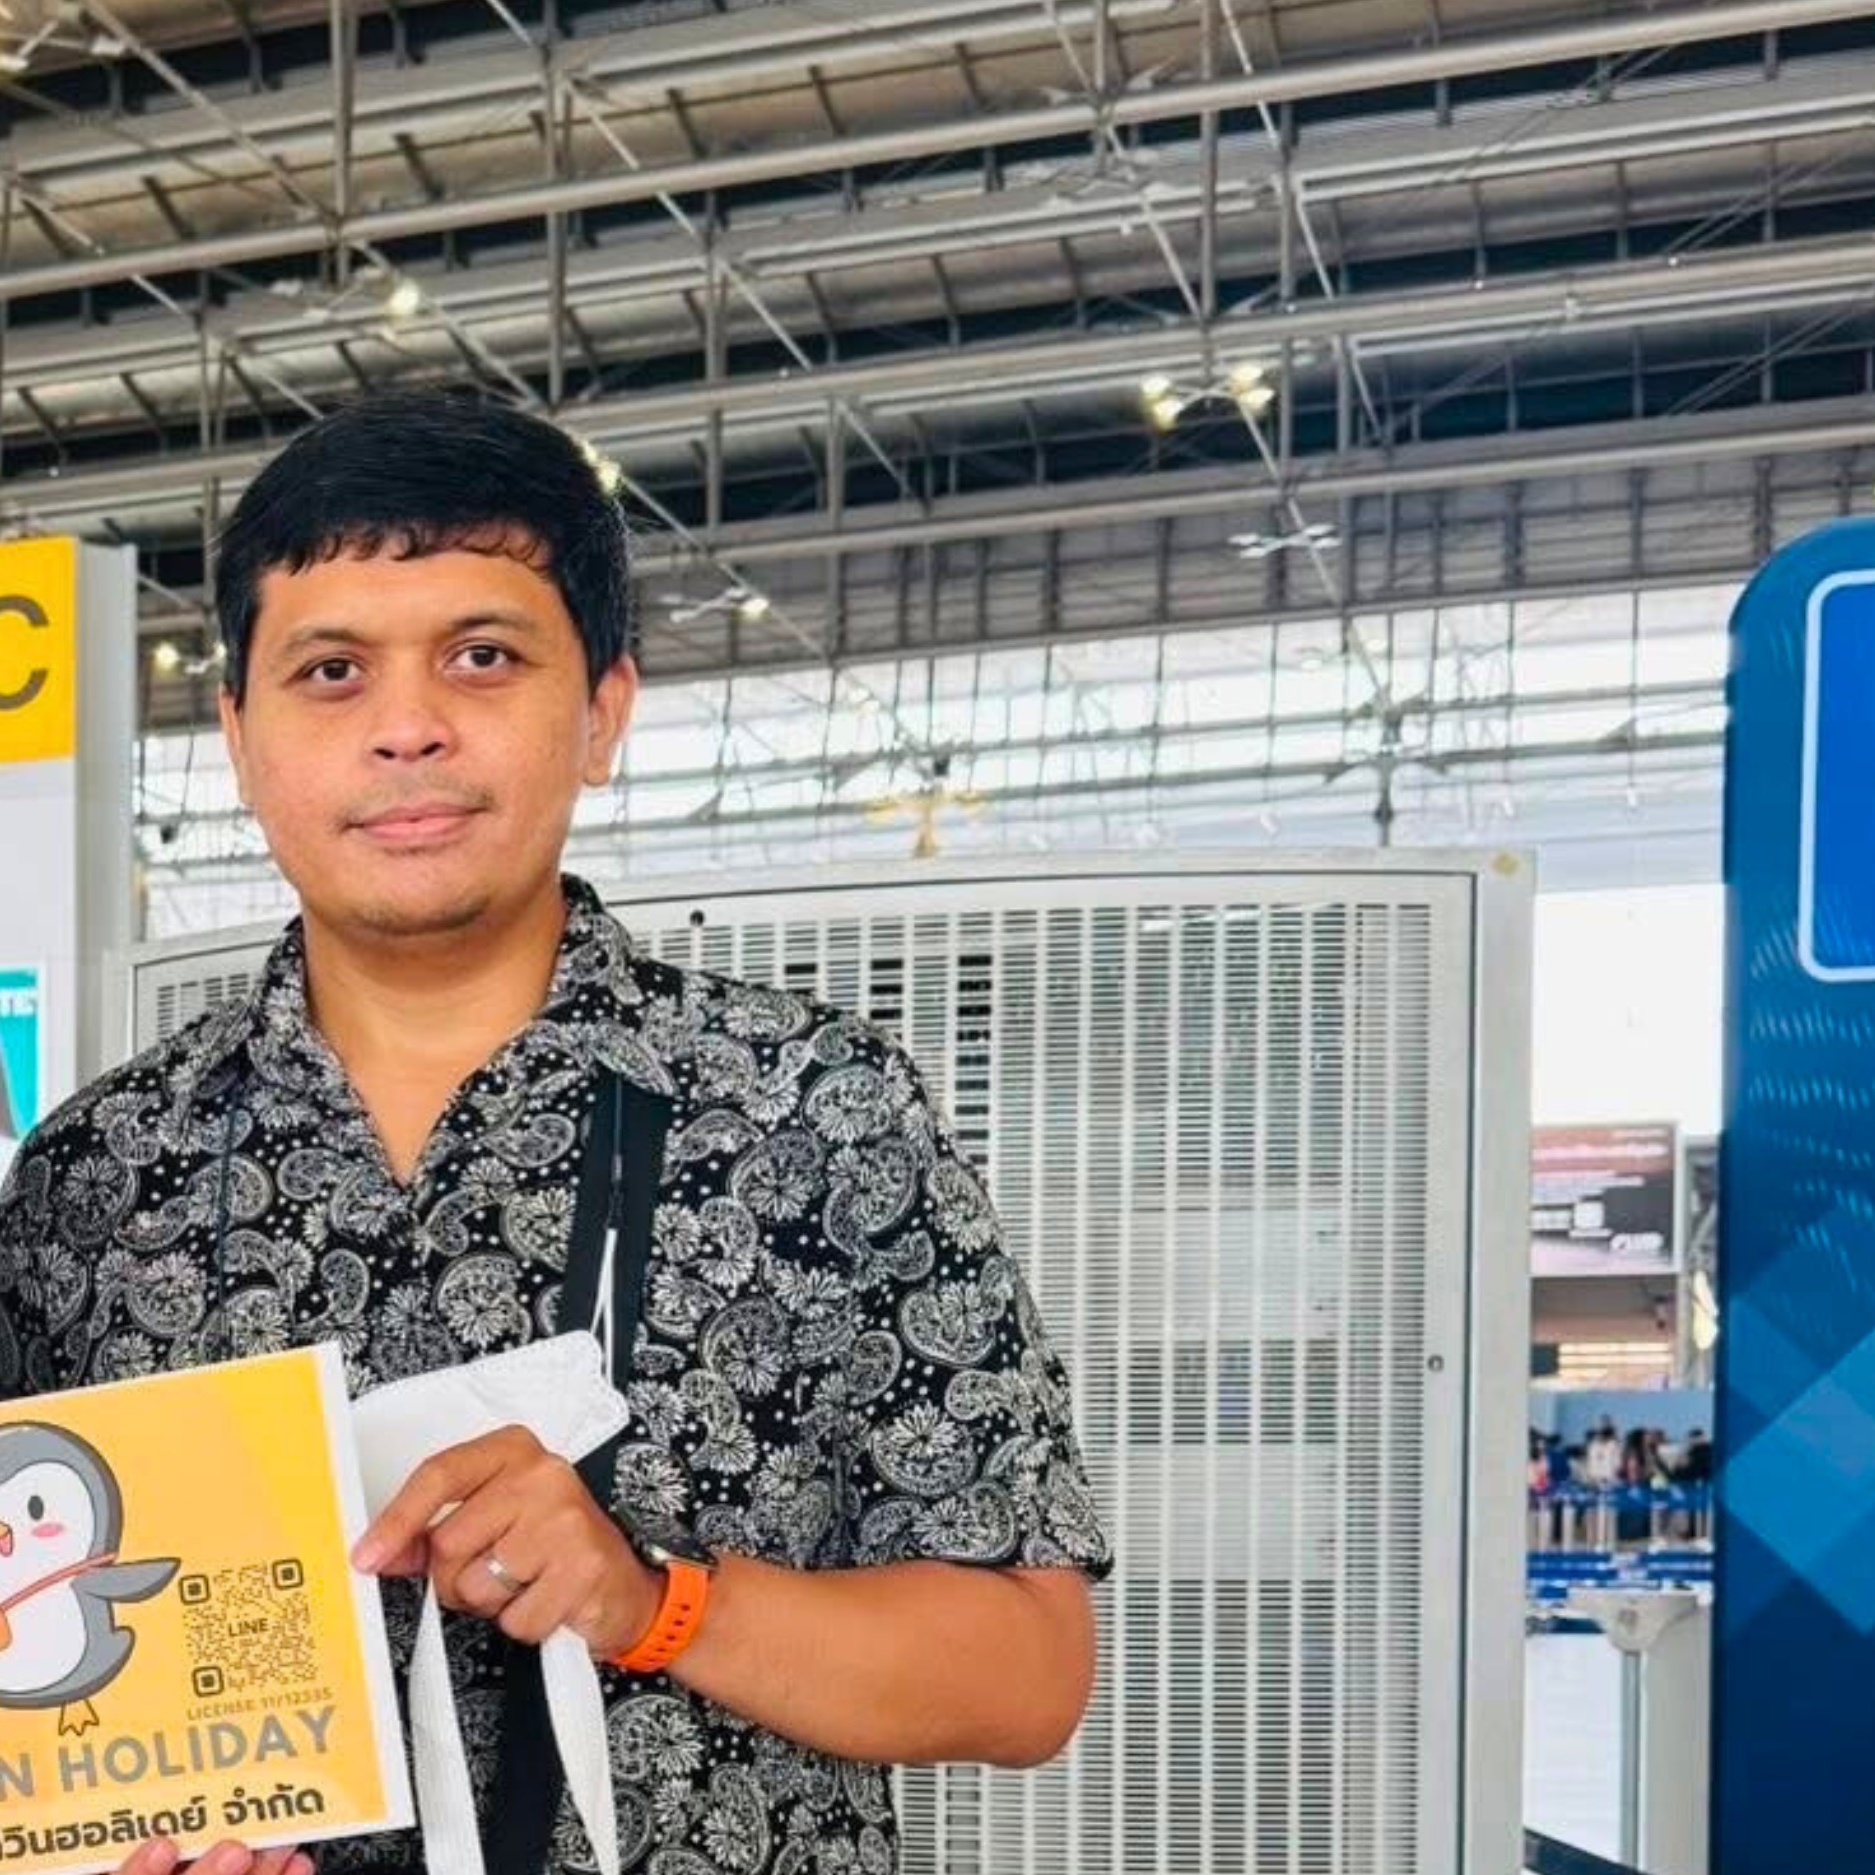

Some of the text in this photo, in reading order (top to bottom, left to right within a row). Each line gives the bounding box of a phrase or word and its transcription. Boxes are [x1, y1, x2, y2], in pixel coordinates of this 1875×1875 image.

[228, 1617, 270, 1638] LINE
[187, 1699, 255, 1721] LICENSE
[57, 1703, 338, 1795] HOLIDAY
[223, 1784, 328, 1828] จำกัด
